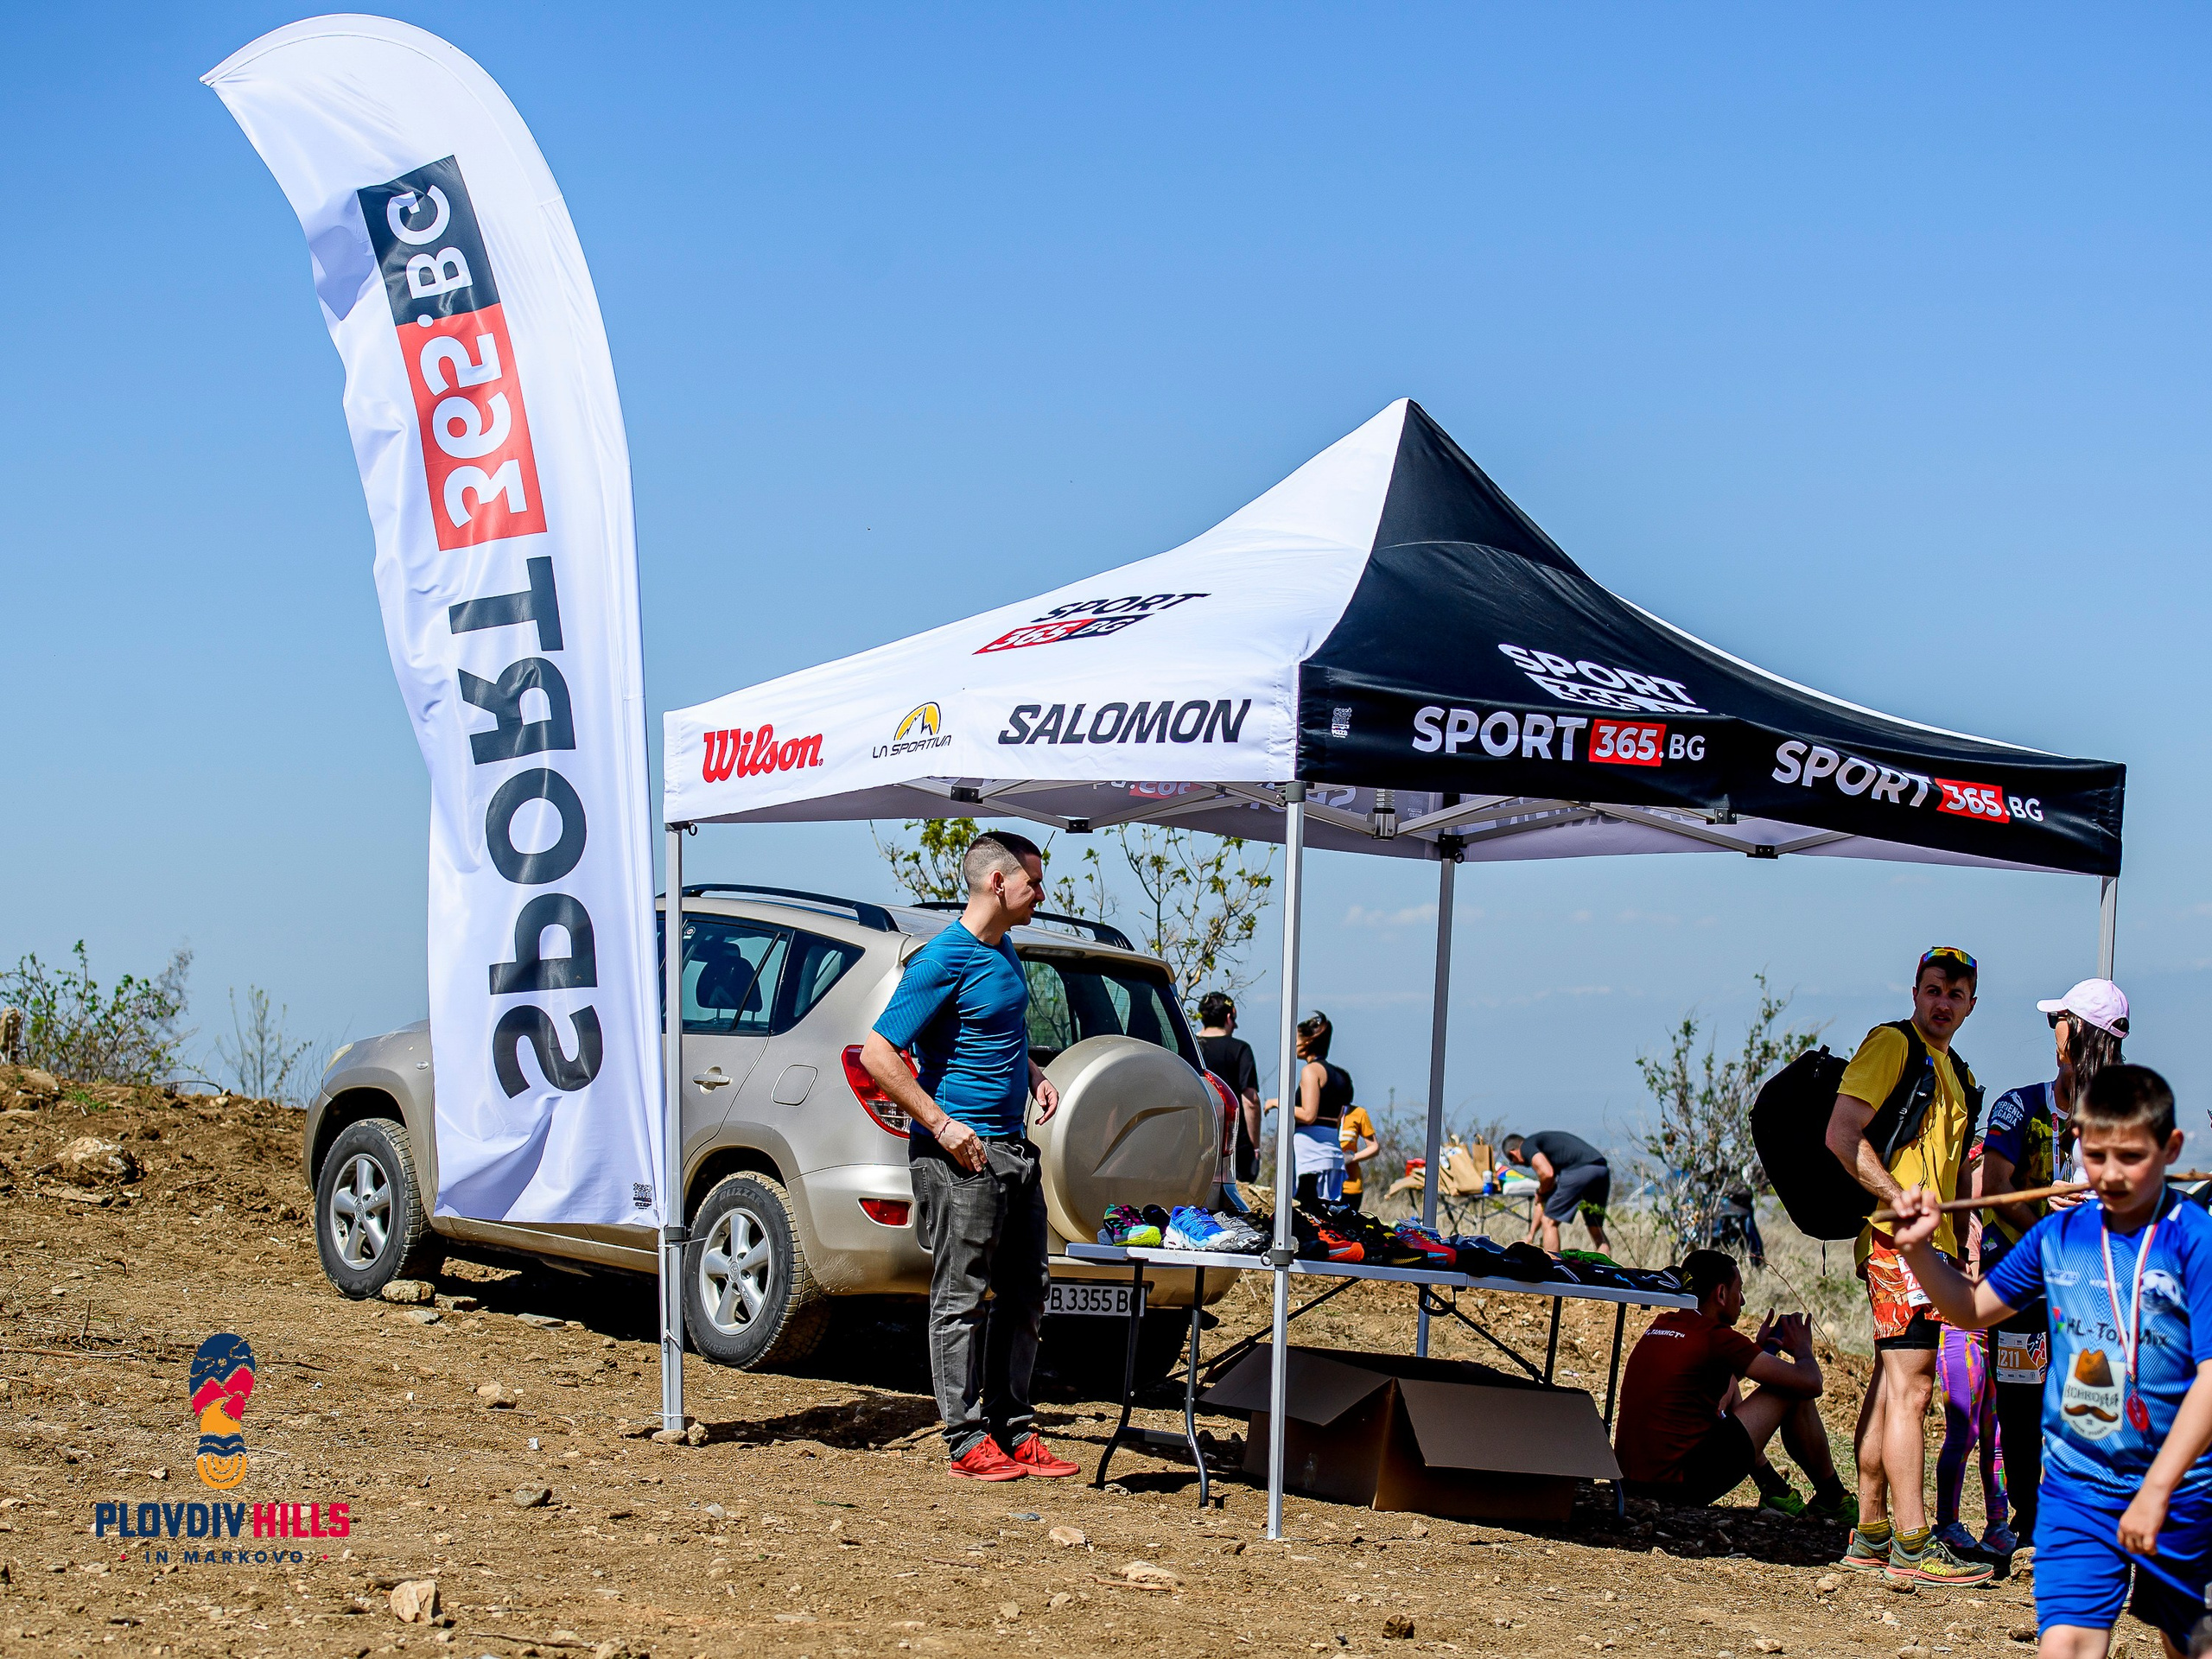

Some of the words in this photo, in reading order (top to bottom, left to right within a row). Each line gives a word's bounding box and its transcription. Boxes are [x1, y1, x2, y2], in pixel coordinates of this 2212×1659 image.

[1031, 593, 1211, 622] SPORT
[1497, 644, 1696, 704] SPORT
[872, 745, 888, 759] LA
[890, 734, 952, 757] SPORTIVA
[998, 699, 1251, 744] SALOMON
[1412, 706, 1587, 761] SPORT
[702, 724, 823, 783] Wilson
[1771, 741, 1933, 807] SPORT
[1066, 1287, 1113, 1313] 3355
